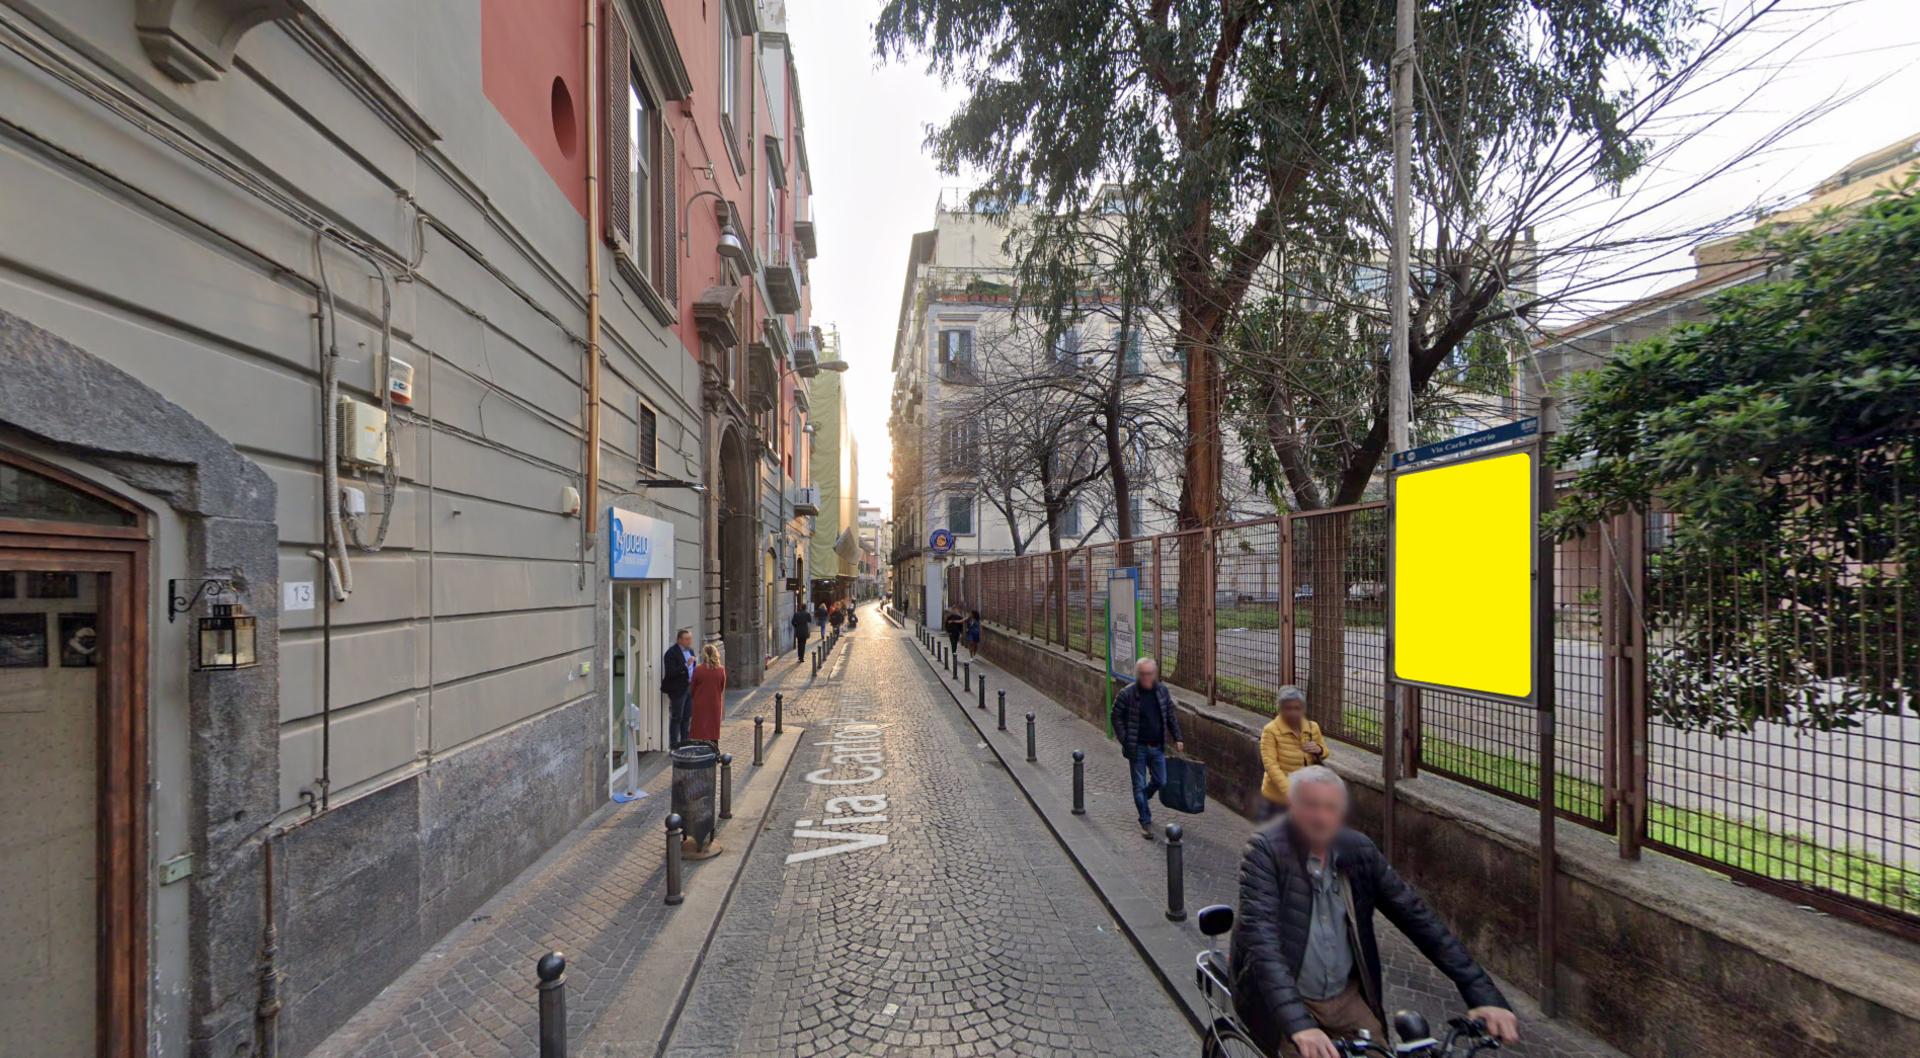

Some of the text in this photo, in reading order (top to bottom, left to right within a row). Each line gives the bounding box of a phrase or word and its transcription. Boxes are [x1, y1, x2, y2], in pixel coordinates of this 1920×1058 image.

[1431, 446, 1444, 454] Via
[1445, 440, 1467, 450] Carlo
[294, 585, 310, 602] 13
